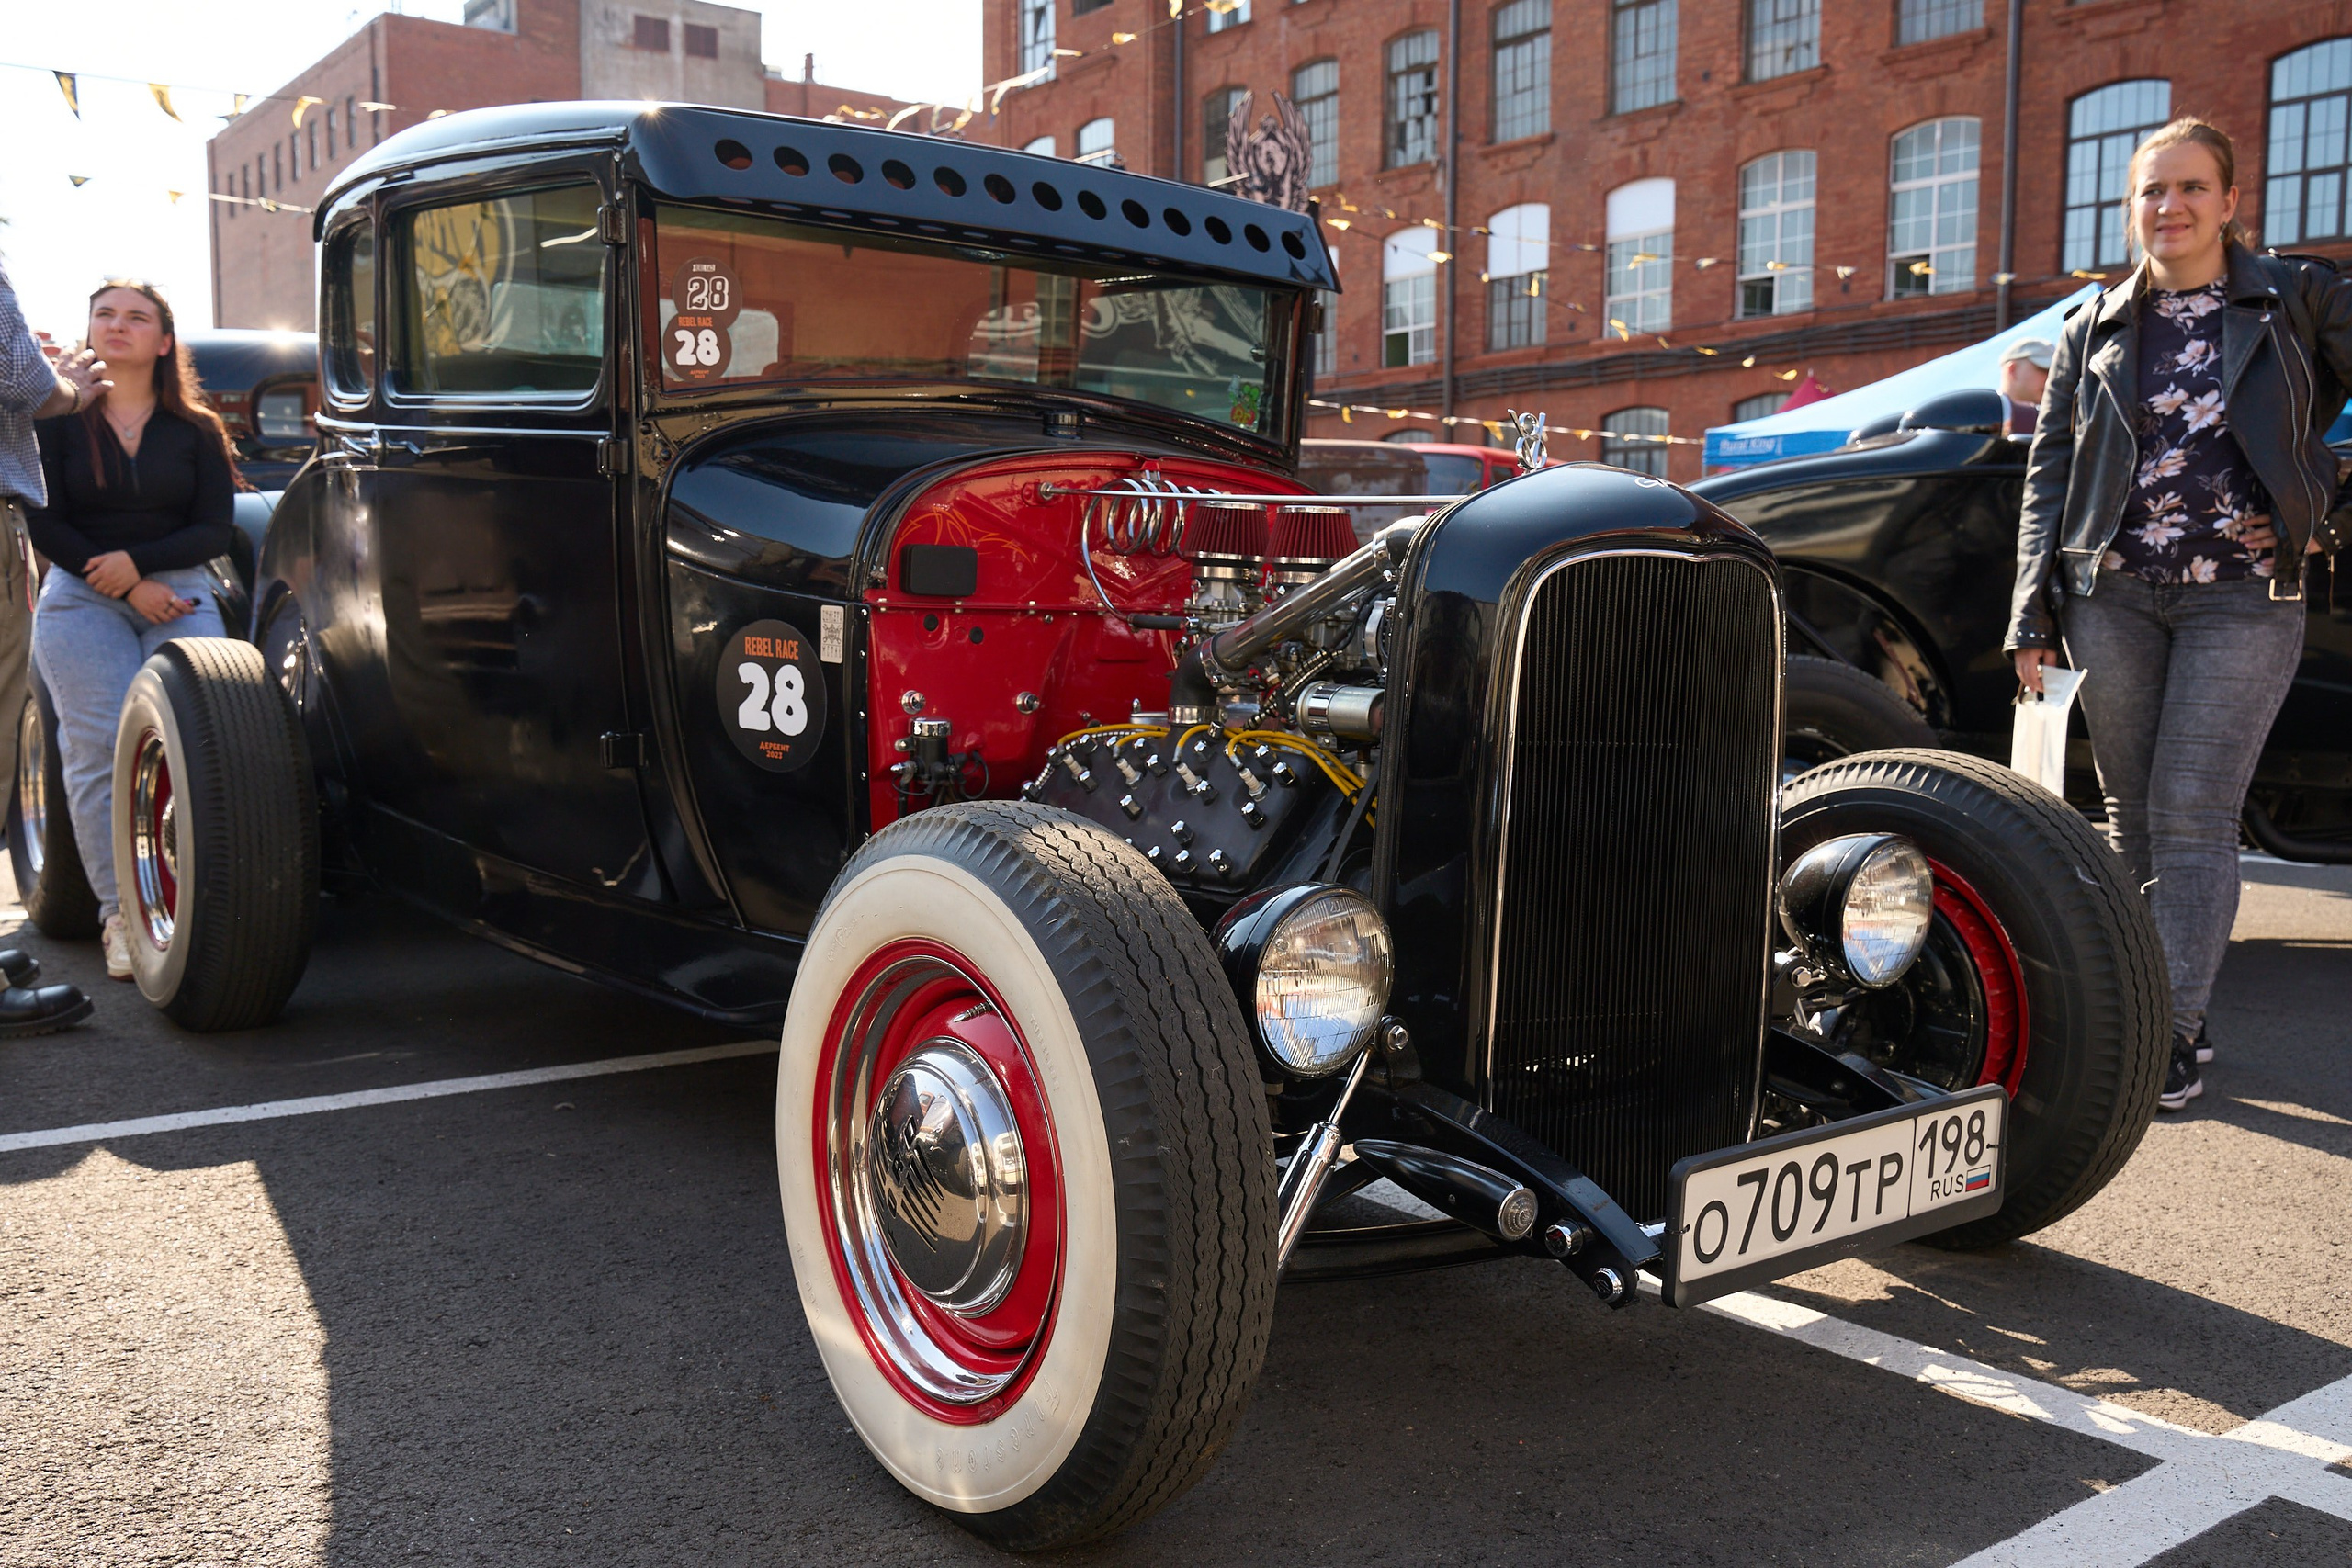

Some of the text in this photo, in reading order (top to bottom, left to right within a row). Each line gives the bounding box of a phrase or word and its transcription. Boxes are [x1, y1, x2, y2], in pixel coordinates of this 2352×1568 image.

[686, 276, 729, 311] 28
[678, 316, 713, 327] REBEL RACE
[674, 329, 721, 367] 28
[744, 636, 774, 658] REBEL
[775, 638, 799, 660] RACE
[737, 661, 808, 737] 28
[1918, 1109, 1986, 1179] 198
[1929, 1173, 1965, 1201] RUS
